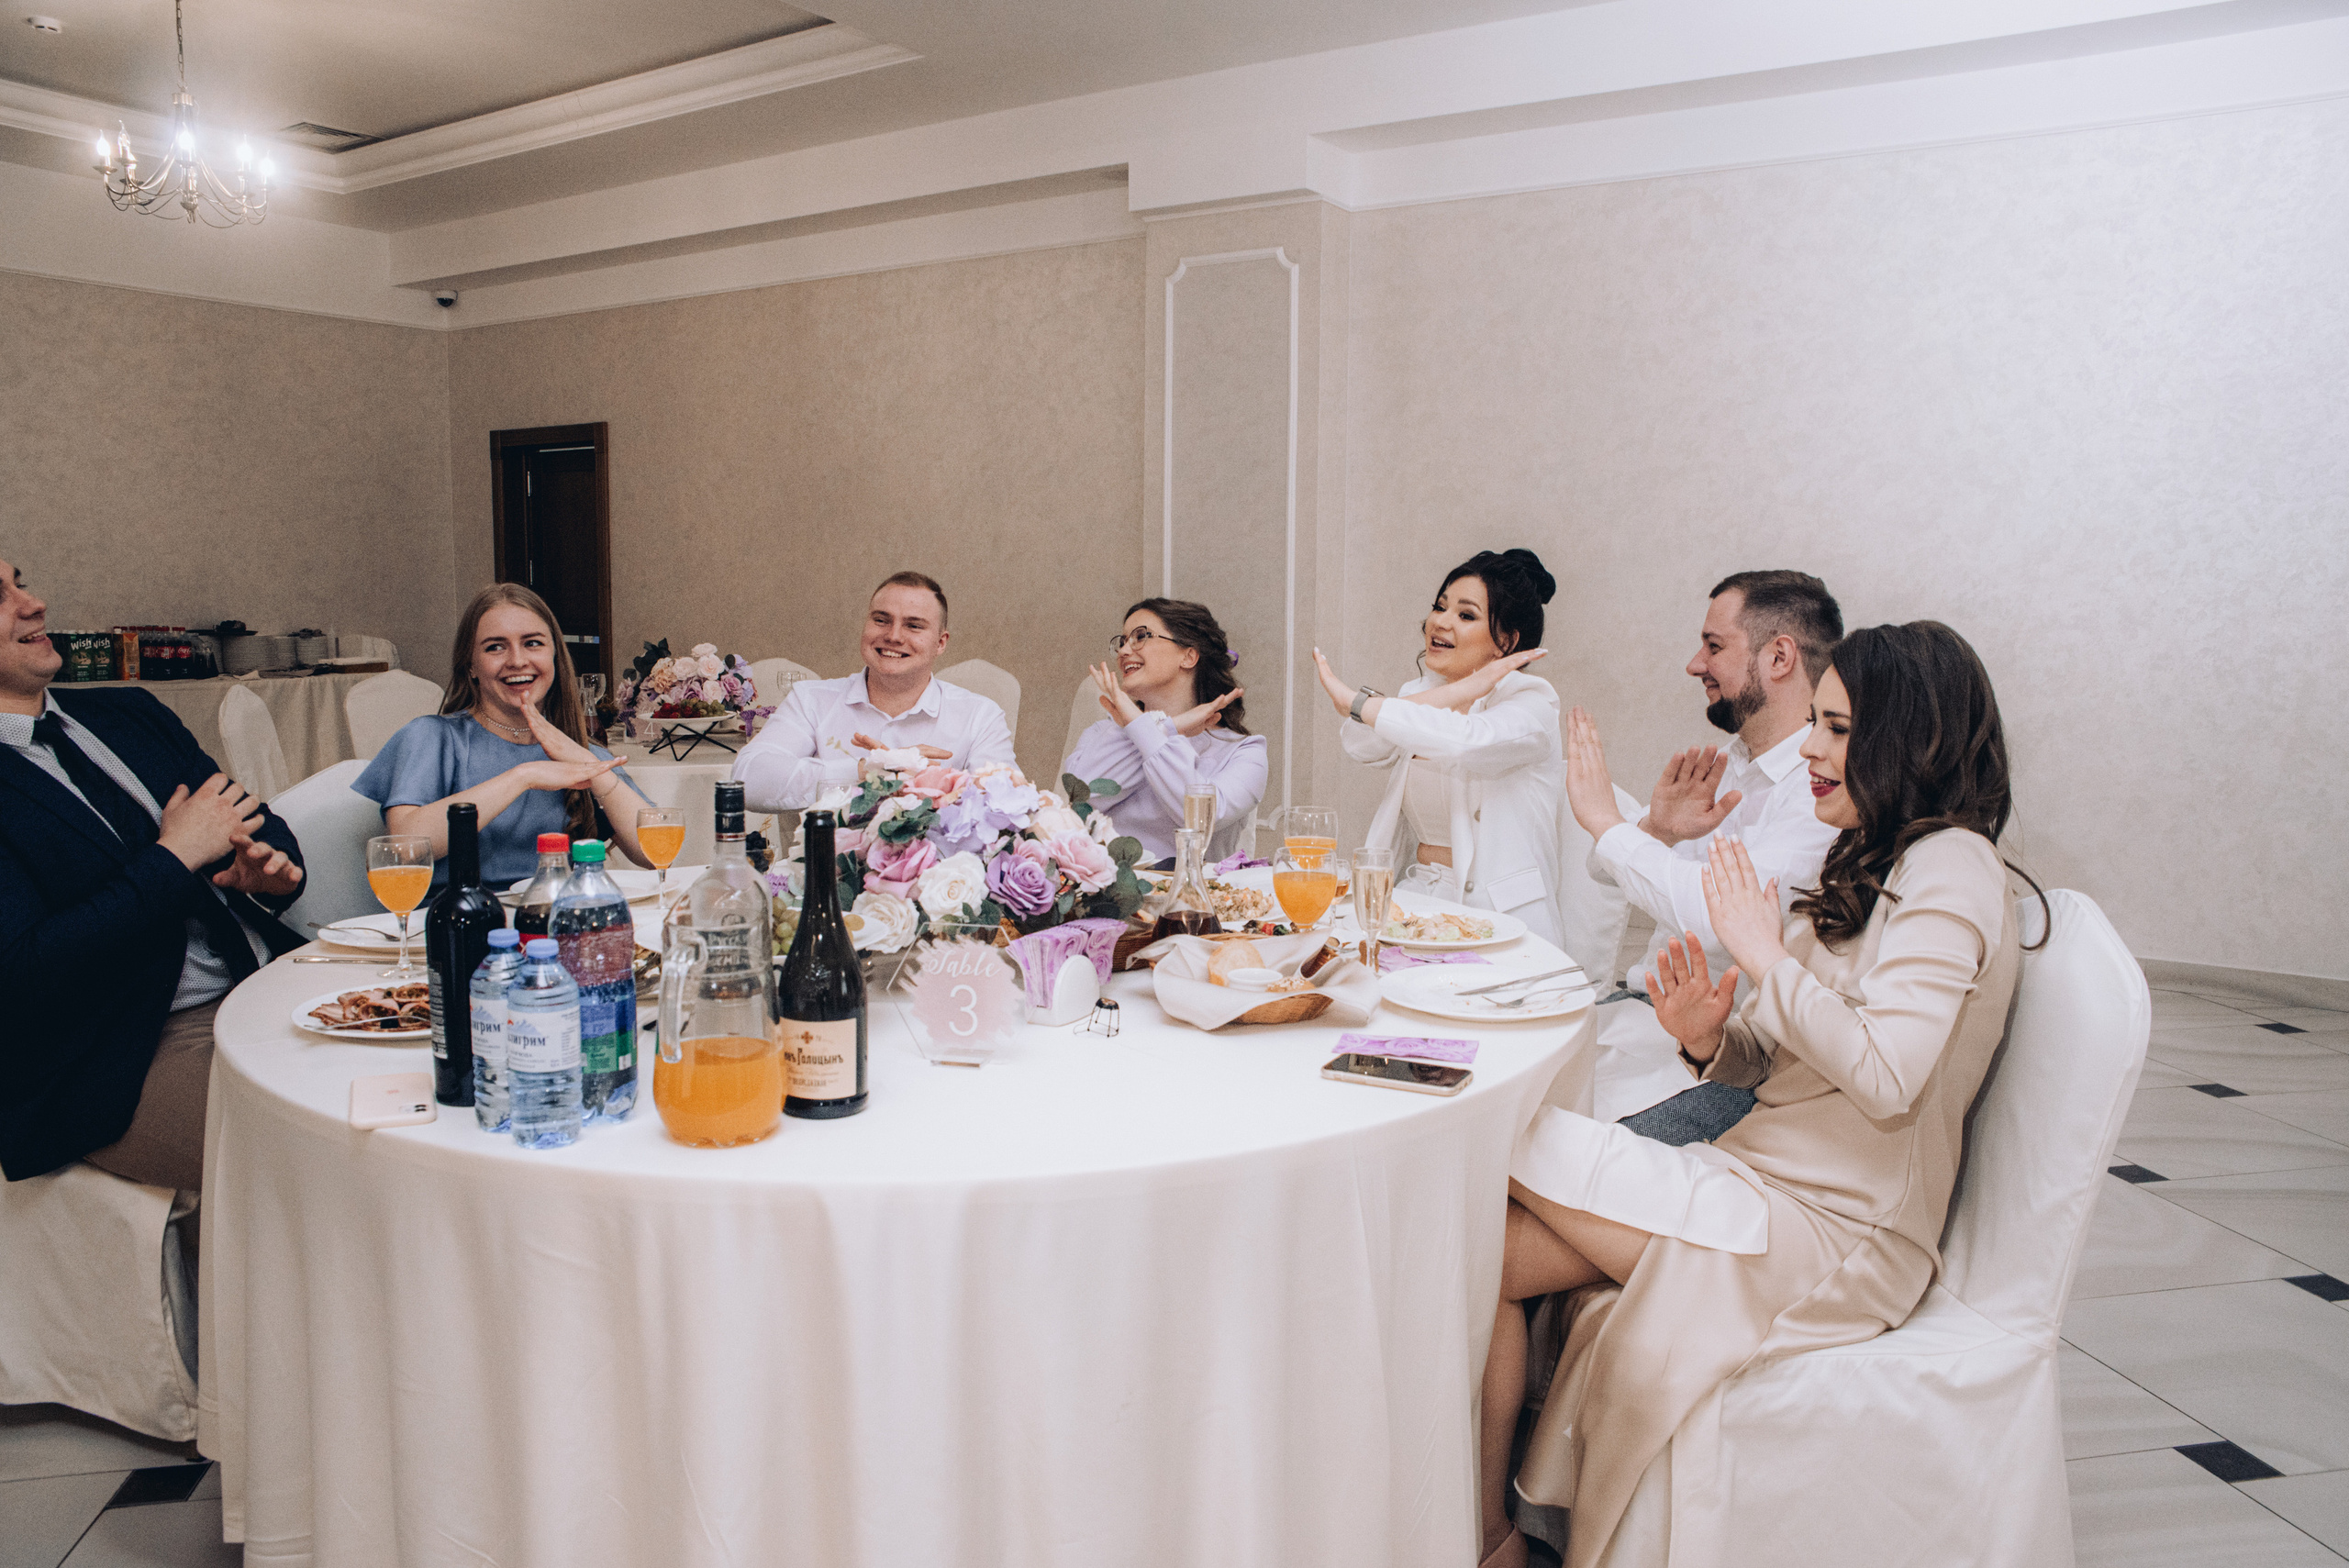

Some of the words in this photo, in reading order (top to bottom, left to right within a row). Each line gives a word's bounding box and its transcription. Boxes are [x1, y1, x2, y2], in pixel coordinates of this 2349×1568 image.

[71, 638, 92, 651] Wish
[643, 721, 655, 738] 4
[921, 950, 1001, 978] Table
[949, 984, 978, 1037] 3
